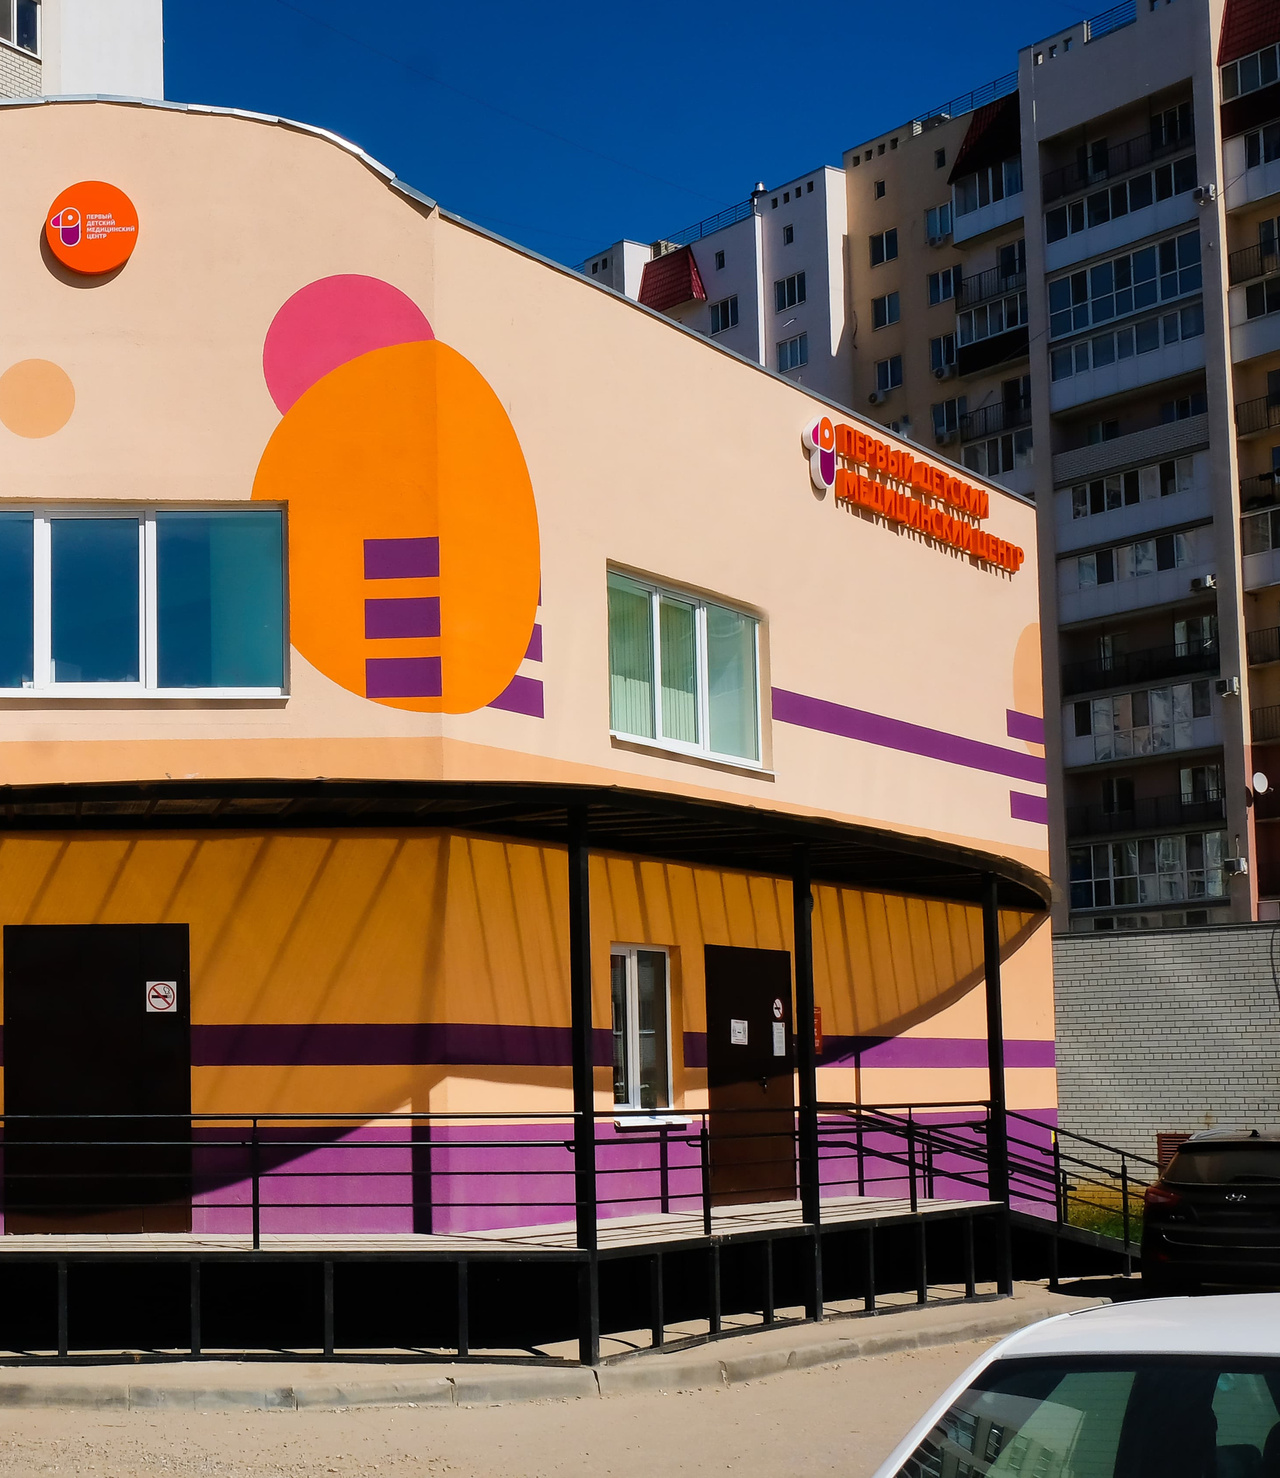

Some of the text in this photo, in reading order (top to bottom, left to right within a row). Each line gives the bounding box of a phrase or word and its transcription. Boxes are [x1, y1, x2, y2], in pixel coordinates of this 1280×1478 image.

[86, 219, 116, 227] ДЕТСКИЙ
[835, 424, 989, 519] ПЕРВЫЙ ДЕТСКИЙ
[836, 469, 1024, 571] МЕДИЦИНСКИЙ ЦЕНТР
